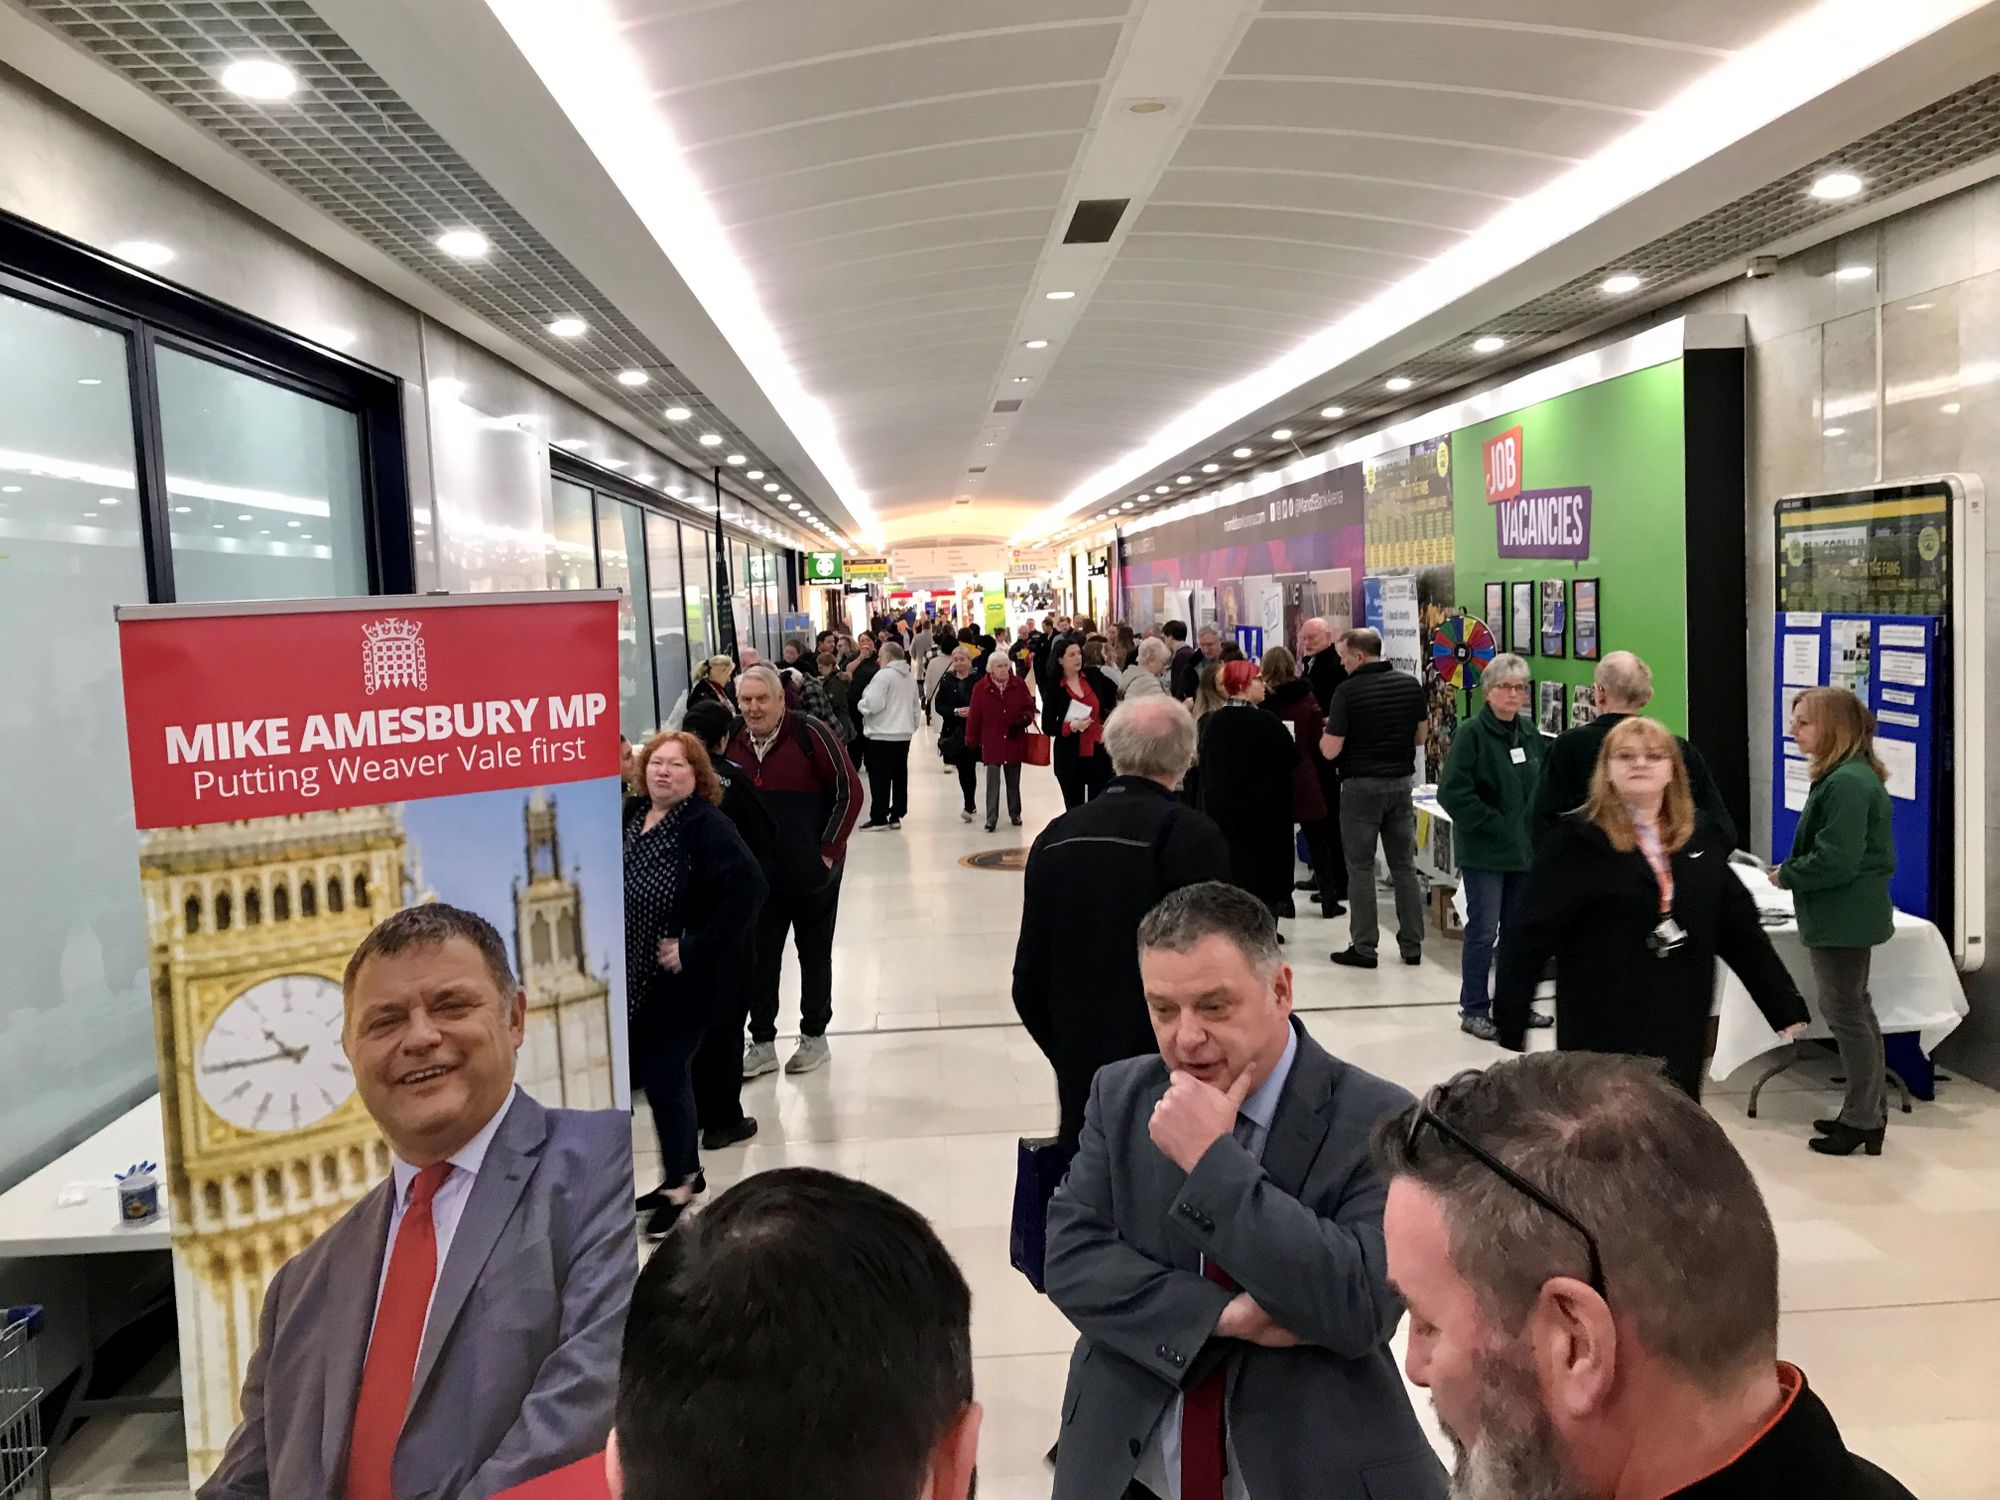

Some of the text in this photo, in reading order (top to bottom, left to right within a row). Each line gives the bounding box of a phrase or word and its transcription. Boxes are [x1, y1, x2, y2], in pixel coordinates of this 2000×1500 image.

[1489, 437, 1516, 495] JOB
[1500, 494, 1583, 546] VACANCIES
[165, 692, 607, 764] MIKE AMESBURY MP
[194, 736, 587, 800] Putting Weaver Vale first
